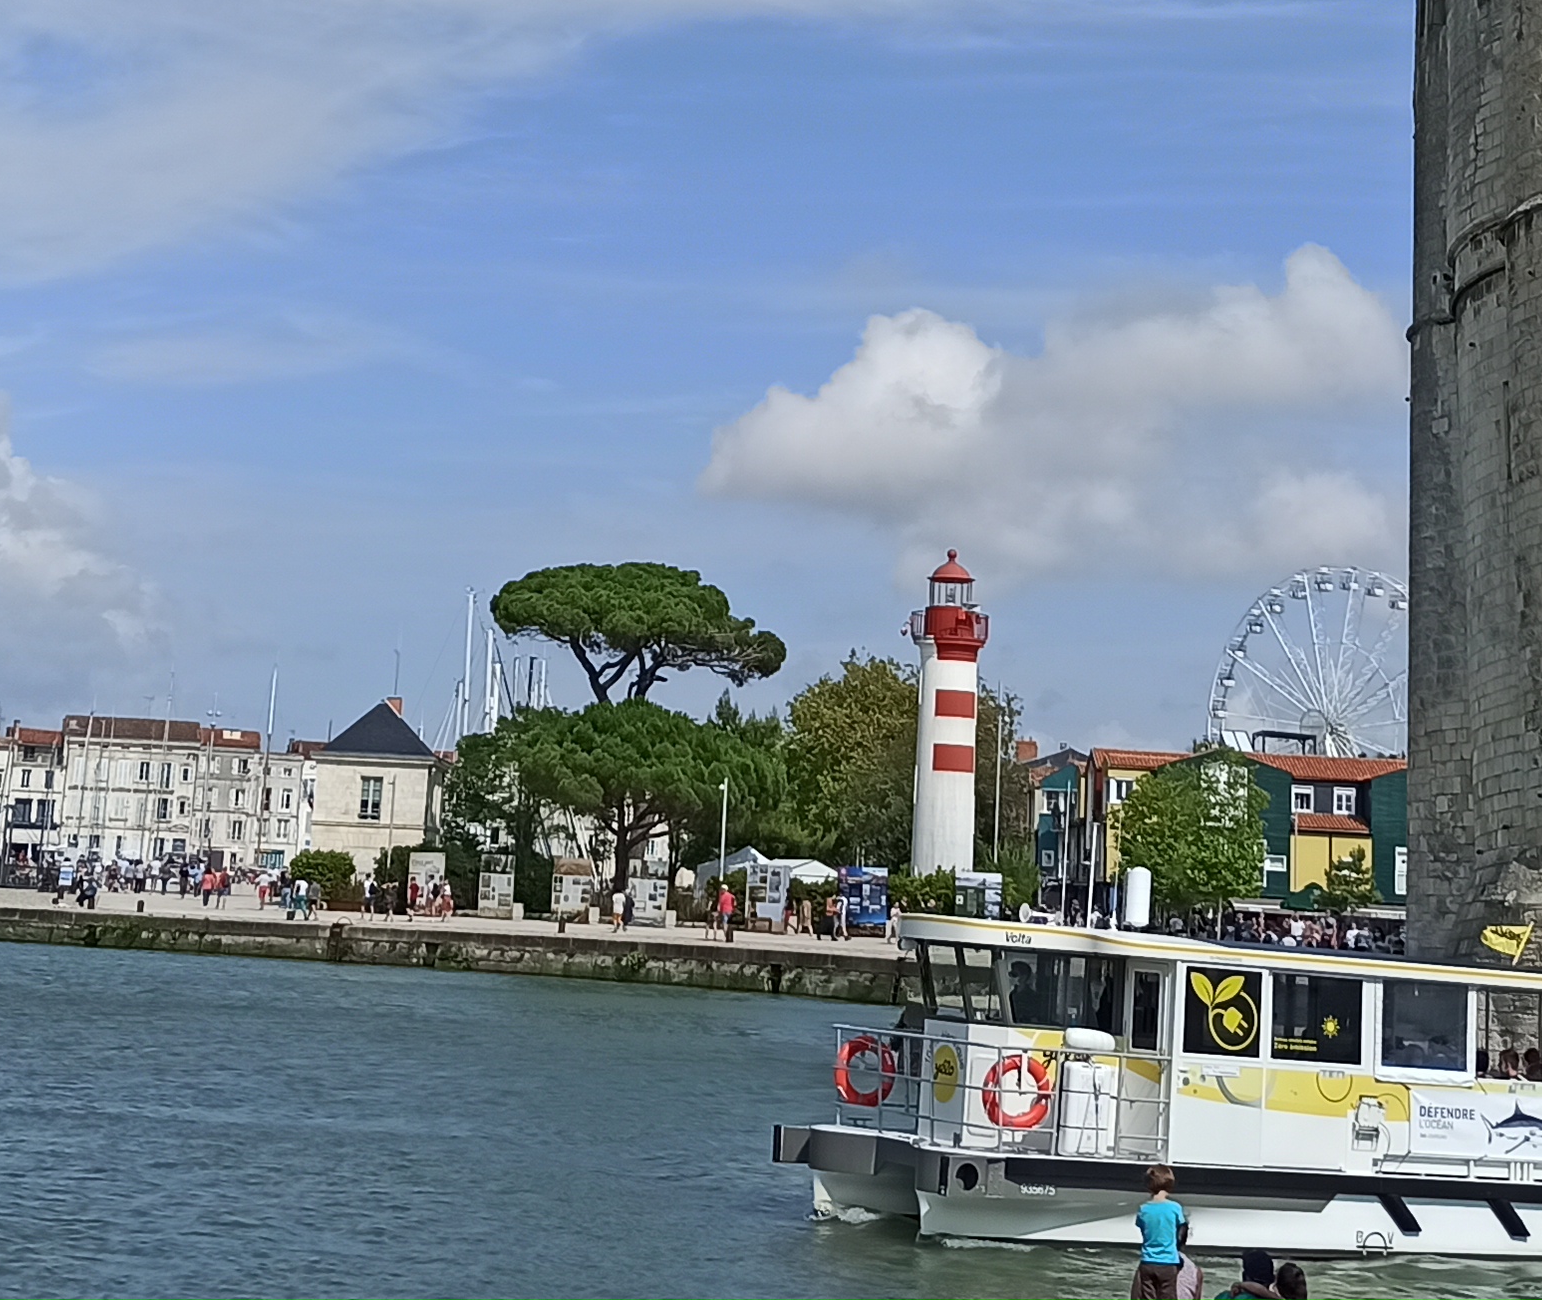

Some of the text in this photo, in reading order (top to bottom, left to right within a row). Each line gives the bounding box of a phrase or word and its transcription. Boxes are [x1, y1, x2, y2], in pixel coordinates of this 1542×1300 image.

[1005, 931, 1032, 945] Volta
[1419, 1102, 1476, 1120] DÉFENDRE
[1419, 1117, 1454, 1130] L'OCÉAN
